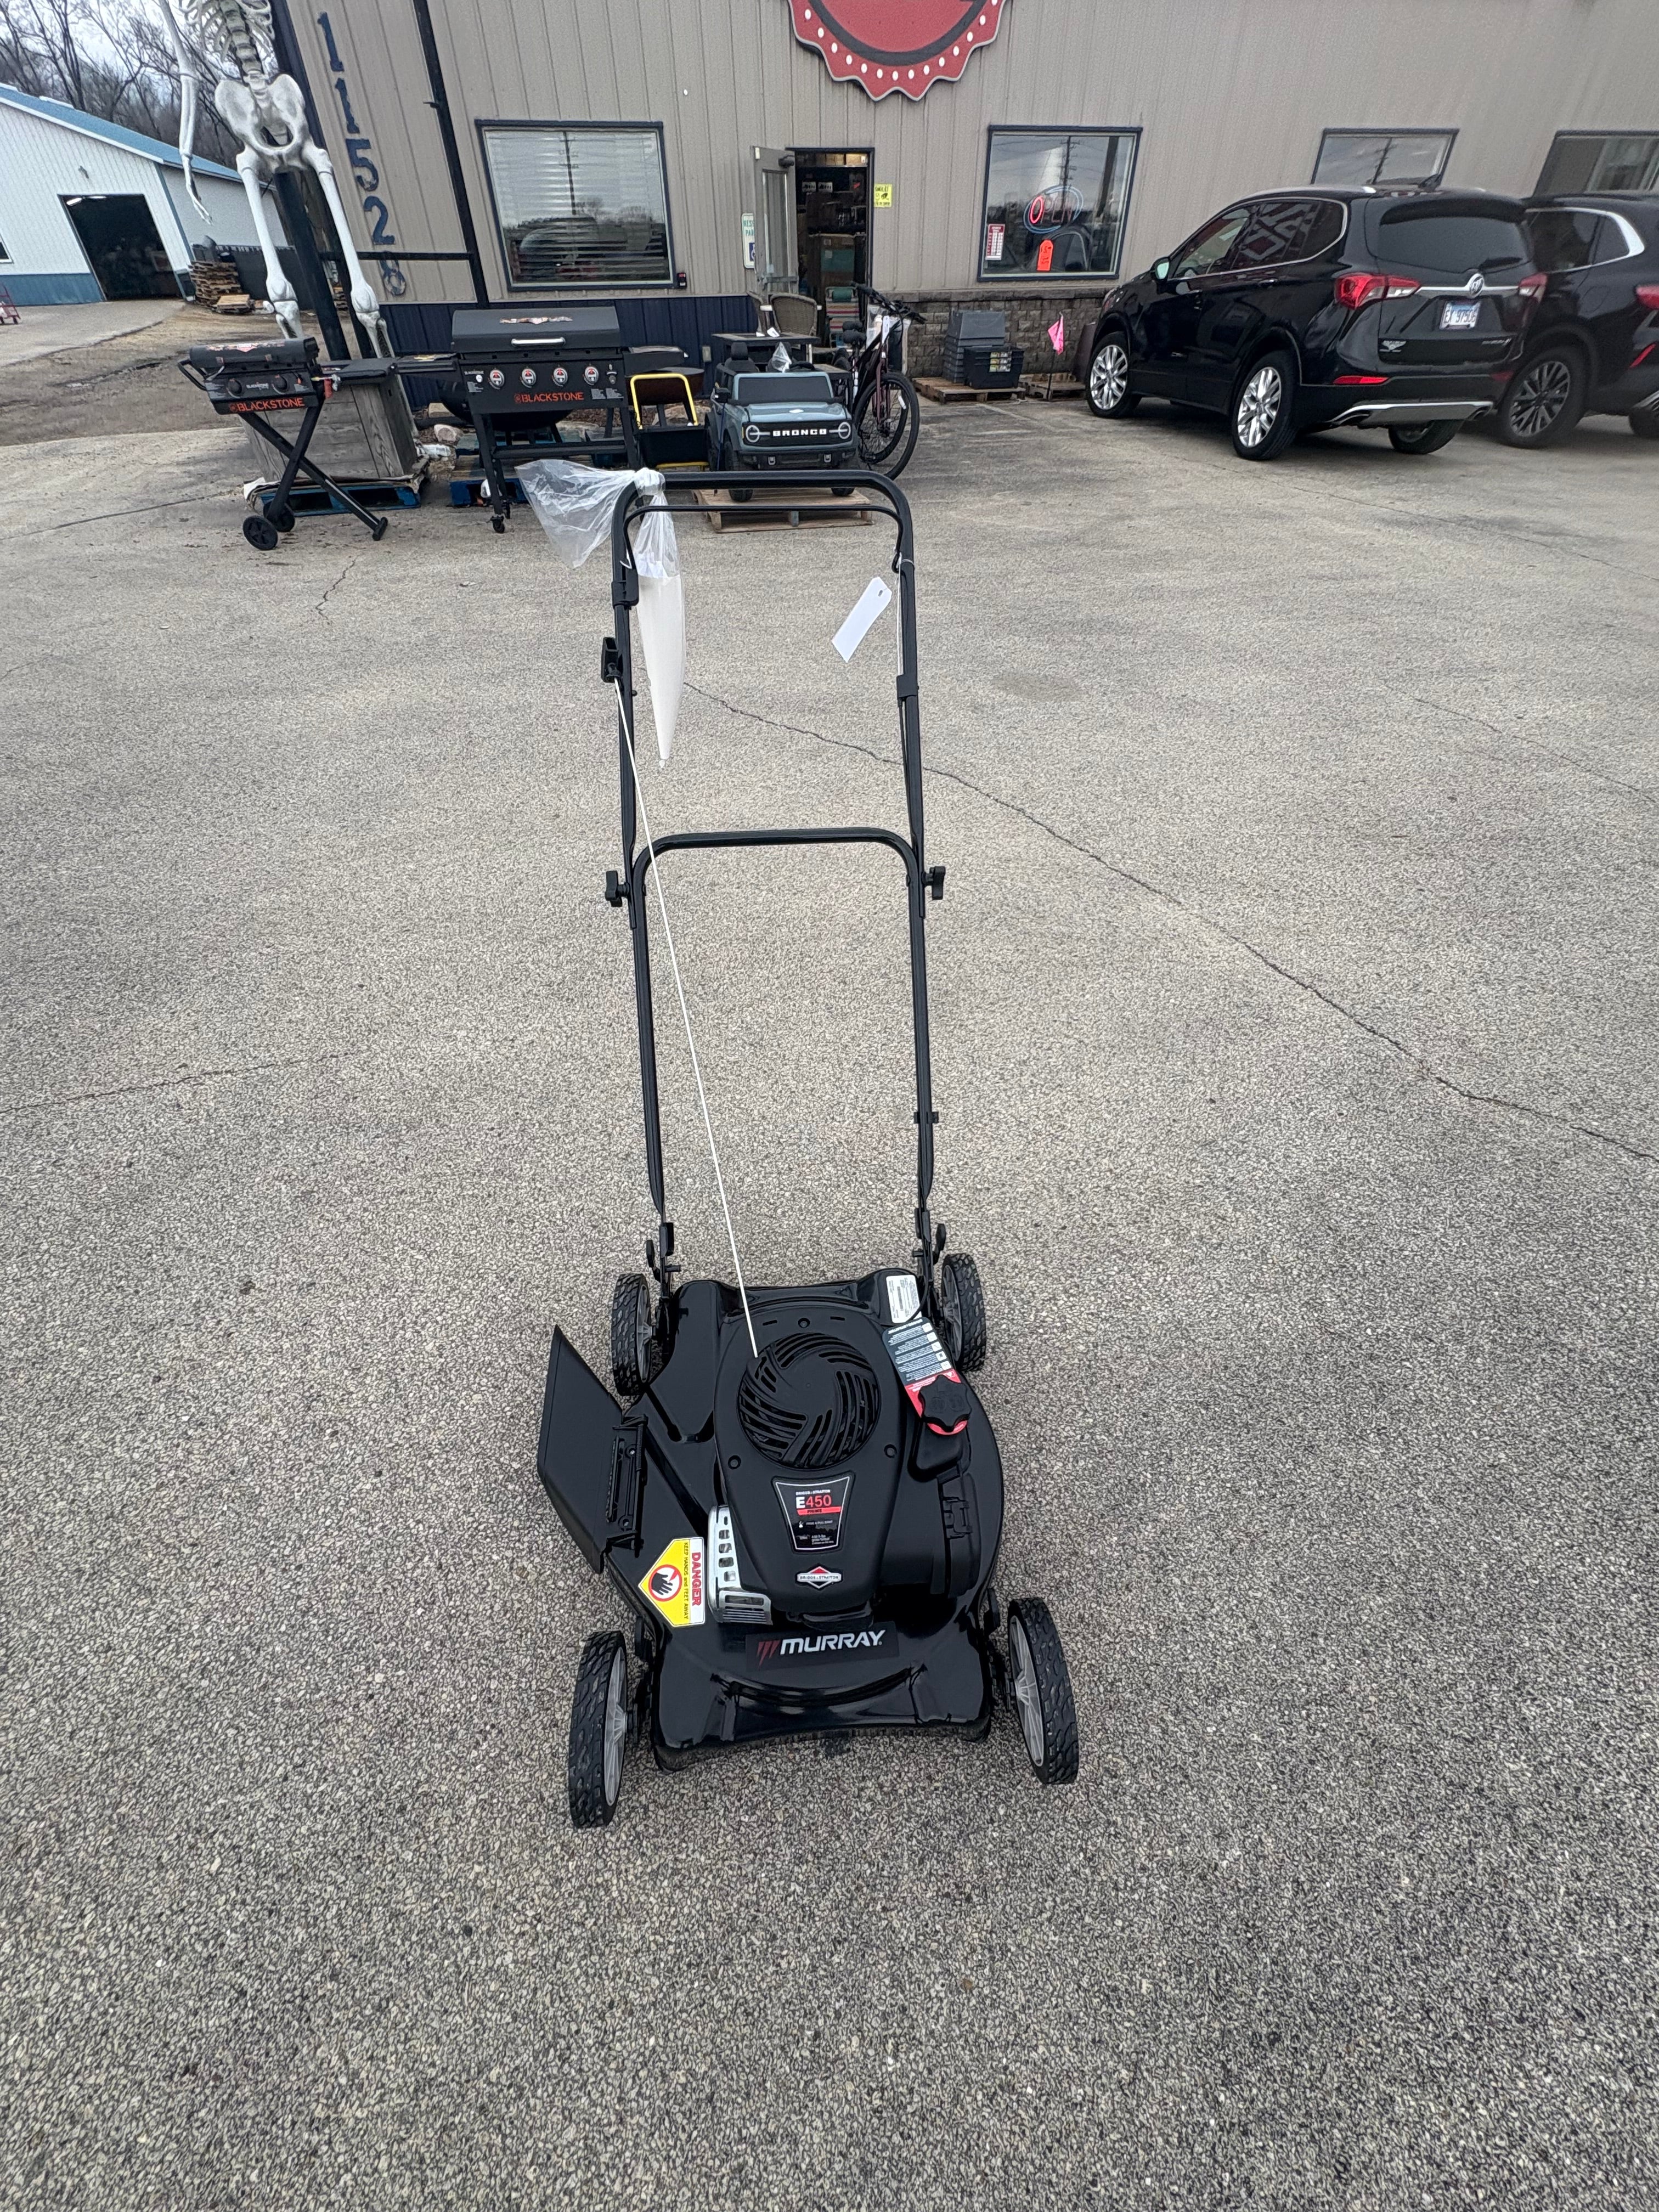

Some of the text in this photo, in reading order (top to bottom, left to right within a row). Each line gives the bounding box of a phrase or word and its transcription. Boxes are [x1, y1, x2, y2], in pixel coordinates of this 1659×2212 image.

[1029, 195, 1075, 224] OPEN
[237, 397, 304, 412] BLACKSTONE
[522, 392, 584, 403] BLACKSTONE
[772, 428, 827, 437] BRONCO
[795, 1494, 832, 1509] E450
[692, 1552, 701, 1606] DANGER
[780, 1629, 885, 1655] MURRAY
